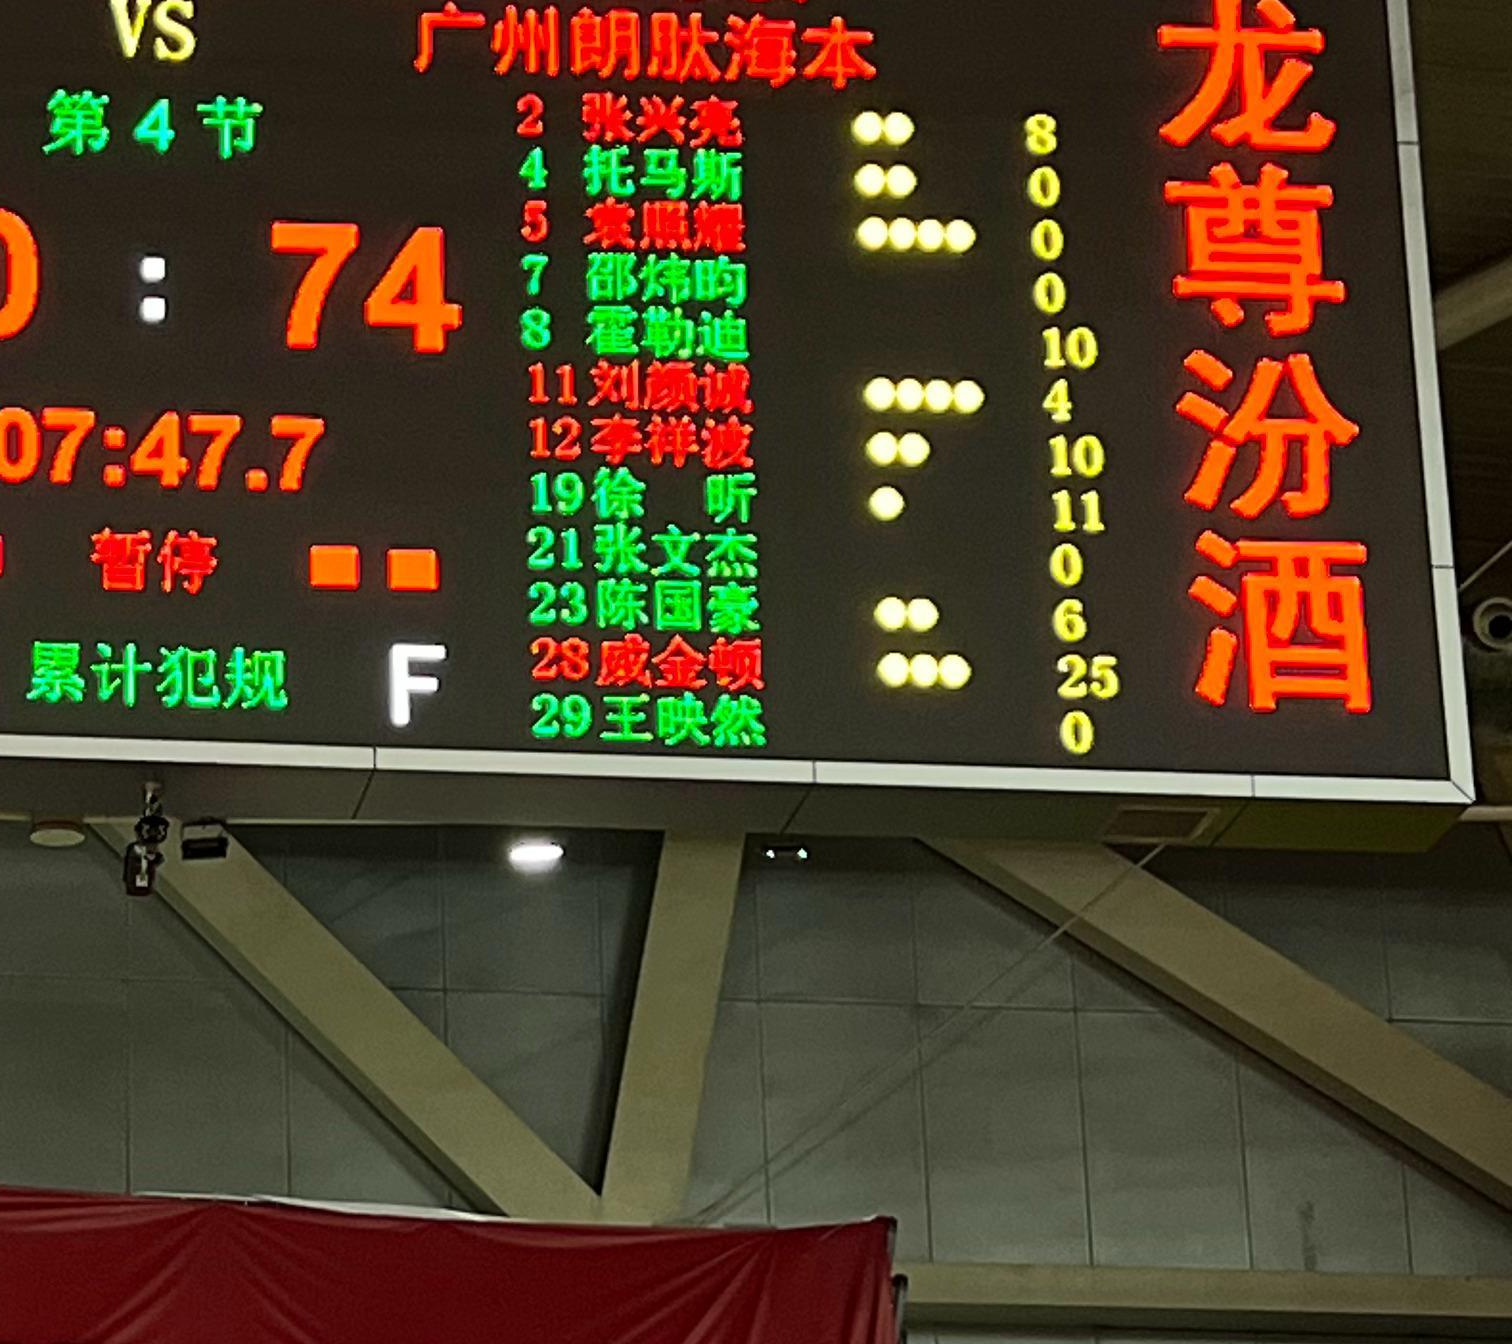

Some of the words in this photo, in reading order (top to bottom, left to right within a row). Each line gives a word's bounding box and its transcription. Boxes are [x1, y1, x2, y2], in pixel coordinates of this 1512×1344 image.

[414, 1, 877, 90] 广州朗肽海本
[42, 89, 110, 156] 第
[132, 99, 176, 154] 4
[196, 95, 264, 160] 节
[516, 93, 544, 137] 2
[581, 92, 745, 148] 张兴亮
[1025, 114, 1057, 154] 8
[519, 146, 549, 190] 4
[582, 144, 743, 200] 托马斯
[1027, 167, 1060, 207] 0
[520, 199, 549, 243] 5
[1031, 219, 1063, 260] 0
[270, 220, 463, 354] 74
[521, 253, 549, 296] 7
[1033, 273, 1065, 314] 0
[520, 307, 551, 350] 8
[585, 305, 750, 362] 霍勒迪
[1043, 327, 1098, 369] 10
[528, 361, 578, 406] 11
[1042, 379, 1072, 423] 4
[529, 416, 583, 461] 12
[590, 413, 754, 470] 李祥波
[1049, 435, 1104, 477] 10
[530, 471, 585, 516] 19
[1052, 490, 1104, 533] 11
[90, 528, 218, 594] 暂停
[527, 526, 583, 571] 21
[593, 522, 758, 578] 张文杰
[1050, 544, 1083, 586] 0
[528, 580, 589, 626] 23
[596, 578, 761, 634] 陈国豪
[1052, 599, 1087, 641] 6
[25, 641, 288, 711] 累计犯规
[389, 643, 446, 726] F
[531, 636, 590, 681] 28
[595, 634, 765, 691] 威金顿
[1057, 655, 1119, 699] 25
[531, 692, 593, 739] 29
[600, 690, 767, 748] 王映然
[1060, 711, 1093, 755] 0
